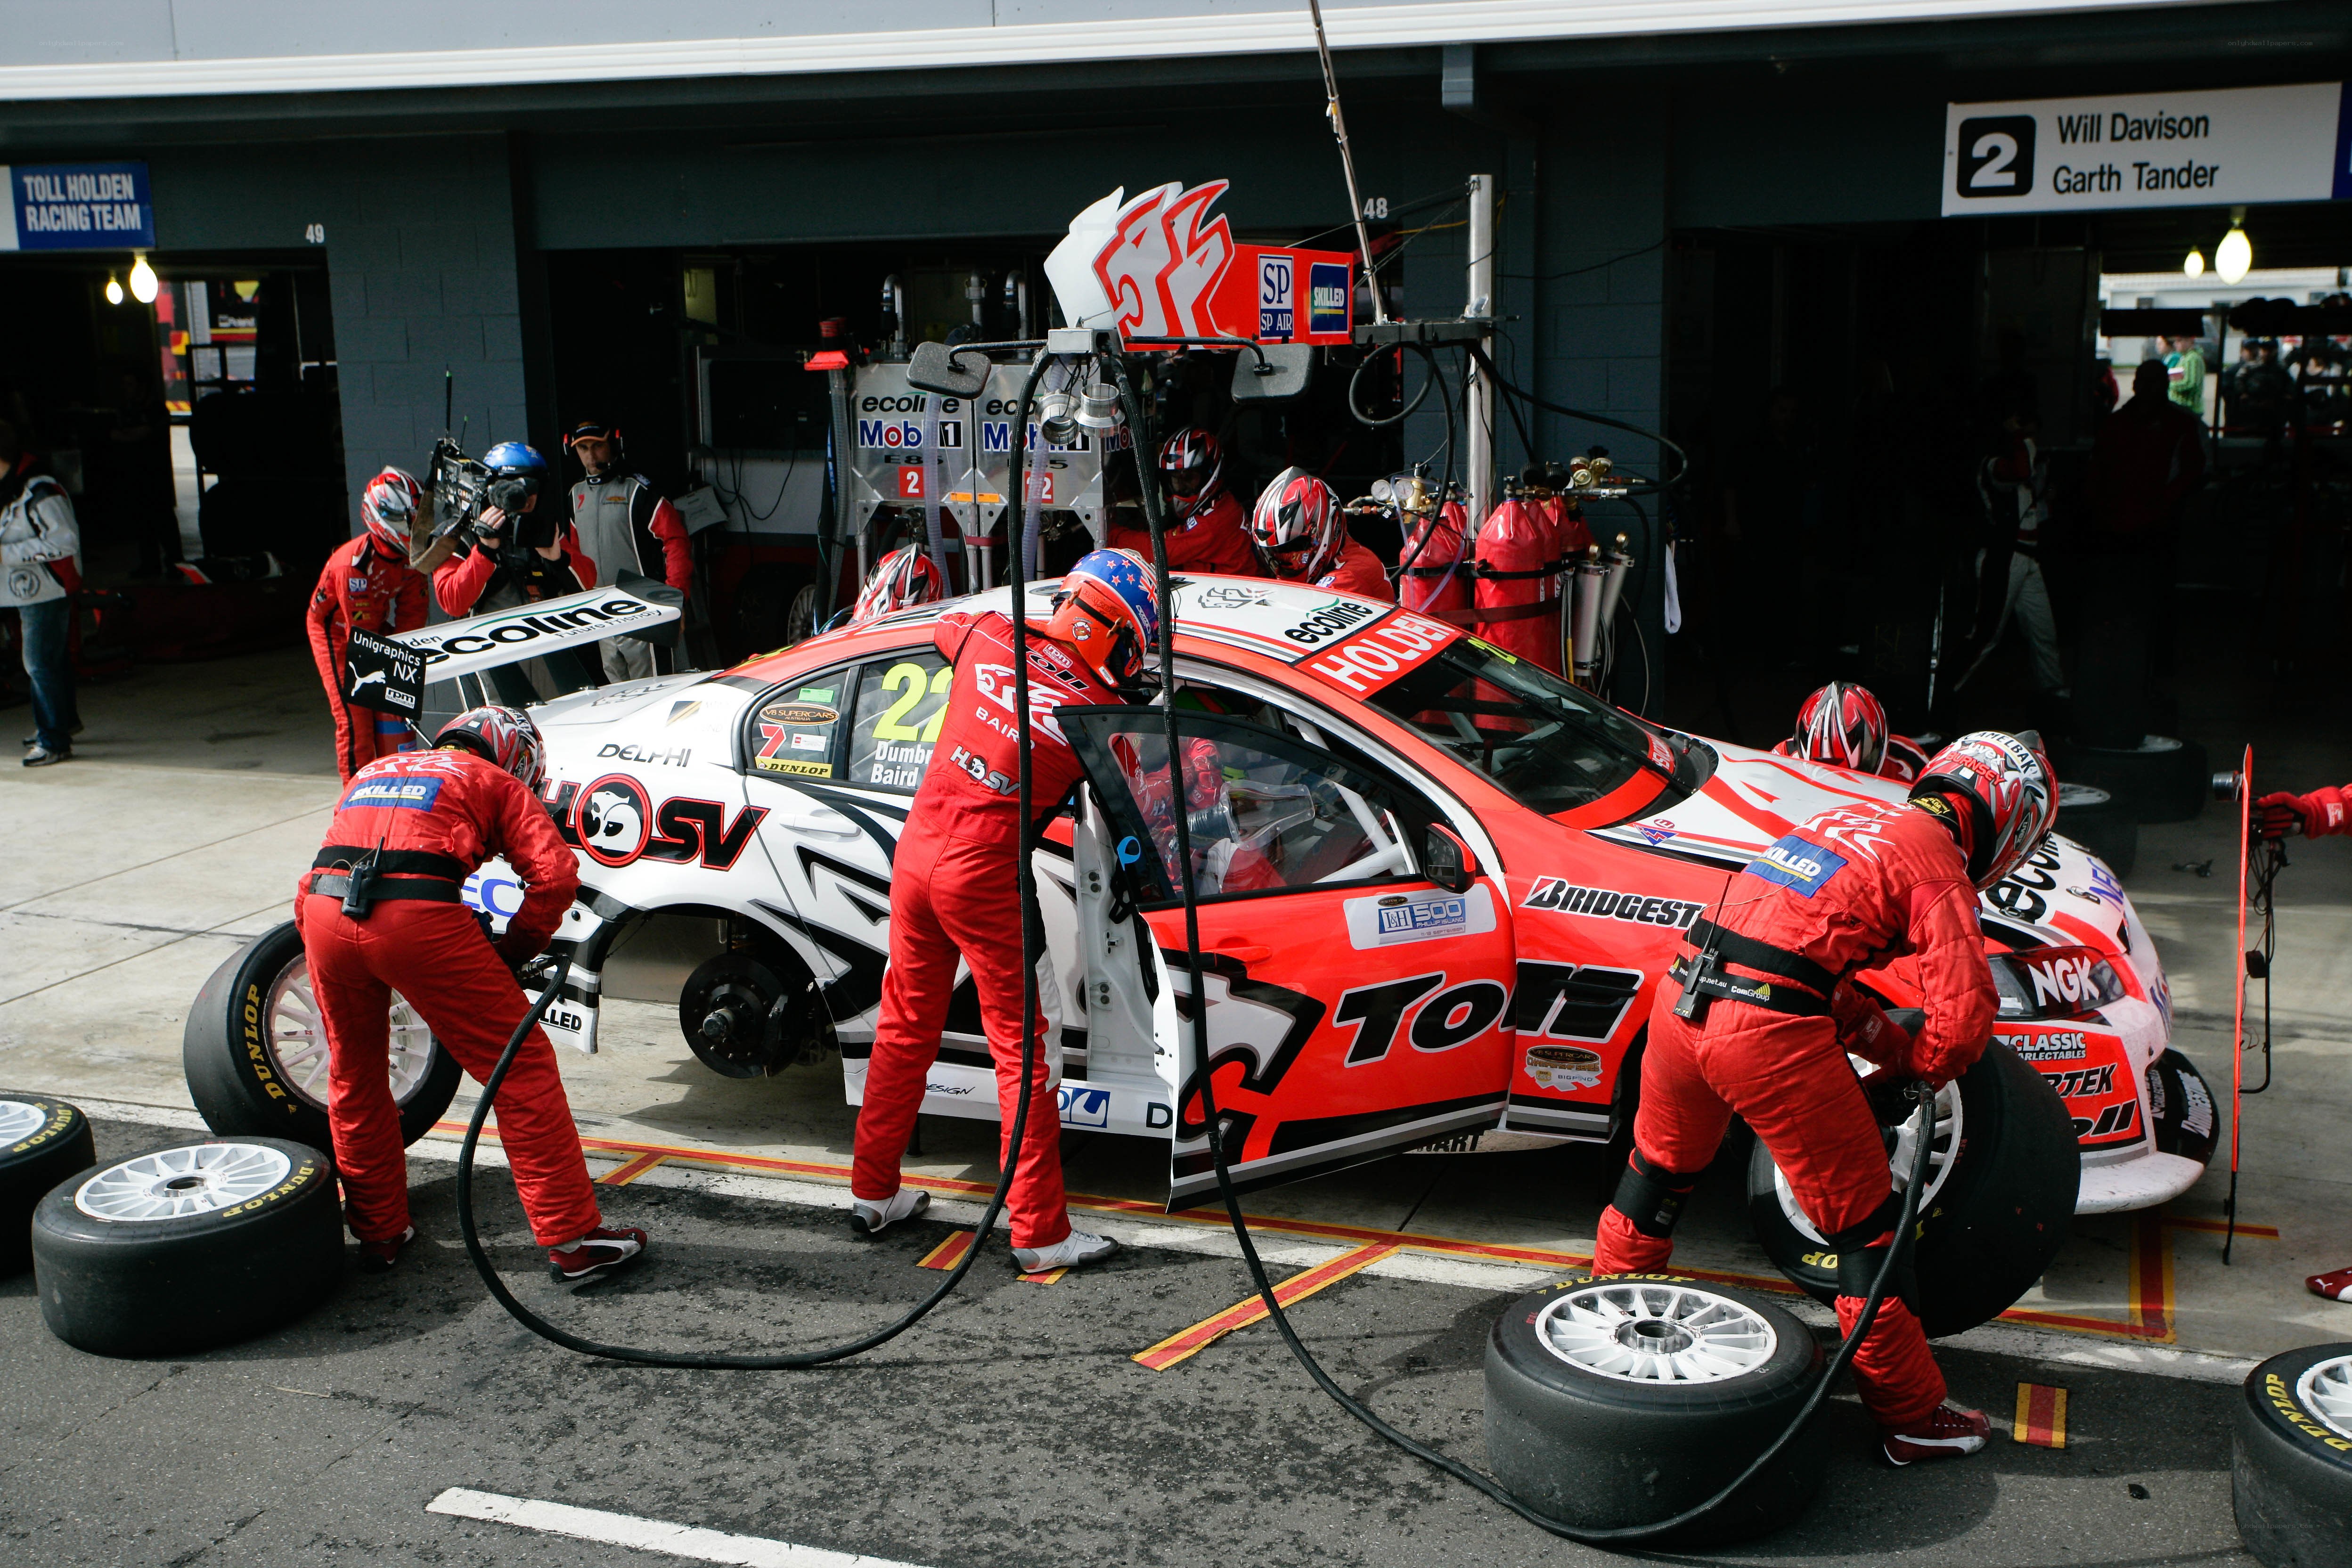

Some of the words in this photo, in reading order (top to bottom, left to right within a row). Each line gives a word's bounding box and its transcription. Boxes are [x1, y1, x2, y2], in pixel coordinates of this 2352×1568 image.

[2058, 113, 2101, 144] Will
[2110, 111, 2209, 141] Davison
[1969, 132, 2018, 188] 2
[23, 175, 66, 202] TOLL
[66, 173, 135, 201] HOLDEN
[2053, 164, 2121, 195] Garth
[2132, 160, 2220, 191] Tander
[25, 205, 91, 232] RACING
[90, 203, 142, 230] TEAM
[1363, 197, 1388, 220] 48
[305, 223, 325, 244] 49
[1263, 262, 1289, 304] SP
[1313, 286, 1345, 307] SKILLED
[1260, 313, 1273, 331] SP
[1276, 313, 1292, 331] AIR
[862, 395, 960, 414] ecolie
[858, 418, 929, 449] Mob
[906, 471, 919, 494] 2
[350, 578, 367, 589] SP
[555, 620, 607, 639] Future
[608, 608, 663, 627] Friendly
[1284, 602, 1373, 645] ecoline
[353, 631, 421, 667] Unigraphics
[1045, 645, 1073, 666] rpm
[1311, 612, 1458, 692] HOLDEN
[393, 661, 417, 685] NX
[388, 689, 415, 704] rpm
[778, 710, 837, 719] SUPERCARS
[759, 723, 787, 759] 7
[596, 744, 693, 768] DELPHI
[1968, 742, 2005, 765] uvex
[768, 763, 828, 775] DUNLOP
[870, 763, 917, 788] Baird
[1945, 751, 2007, 786] BURNSEY
[1414, 900, 1462, 922] 500
[1416, 920, 1441, 928] PHILLIP
[1441, 917, 1464, 925] ISLAND
[2026, 956, 2099, 1006] NGK
[1731, 985, 1770, 1003] ComGroup
[244, 984, 286, 1100] DUNLOP
[2009, 1032, 2086, 1052] CLASSIC
[1544, 1051, 1596, 1060] SUPERCARS
[12, 1109, 73, 1153] DUNLOP
[222, 1167, 315, 1218] DUNLOP
[1554, 1273, 1698, 1290] DUNLOP
[2265, 1373, 2352, 1451] DUNLOP
